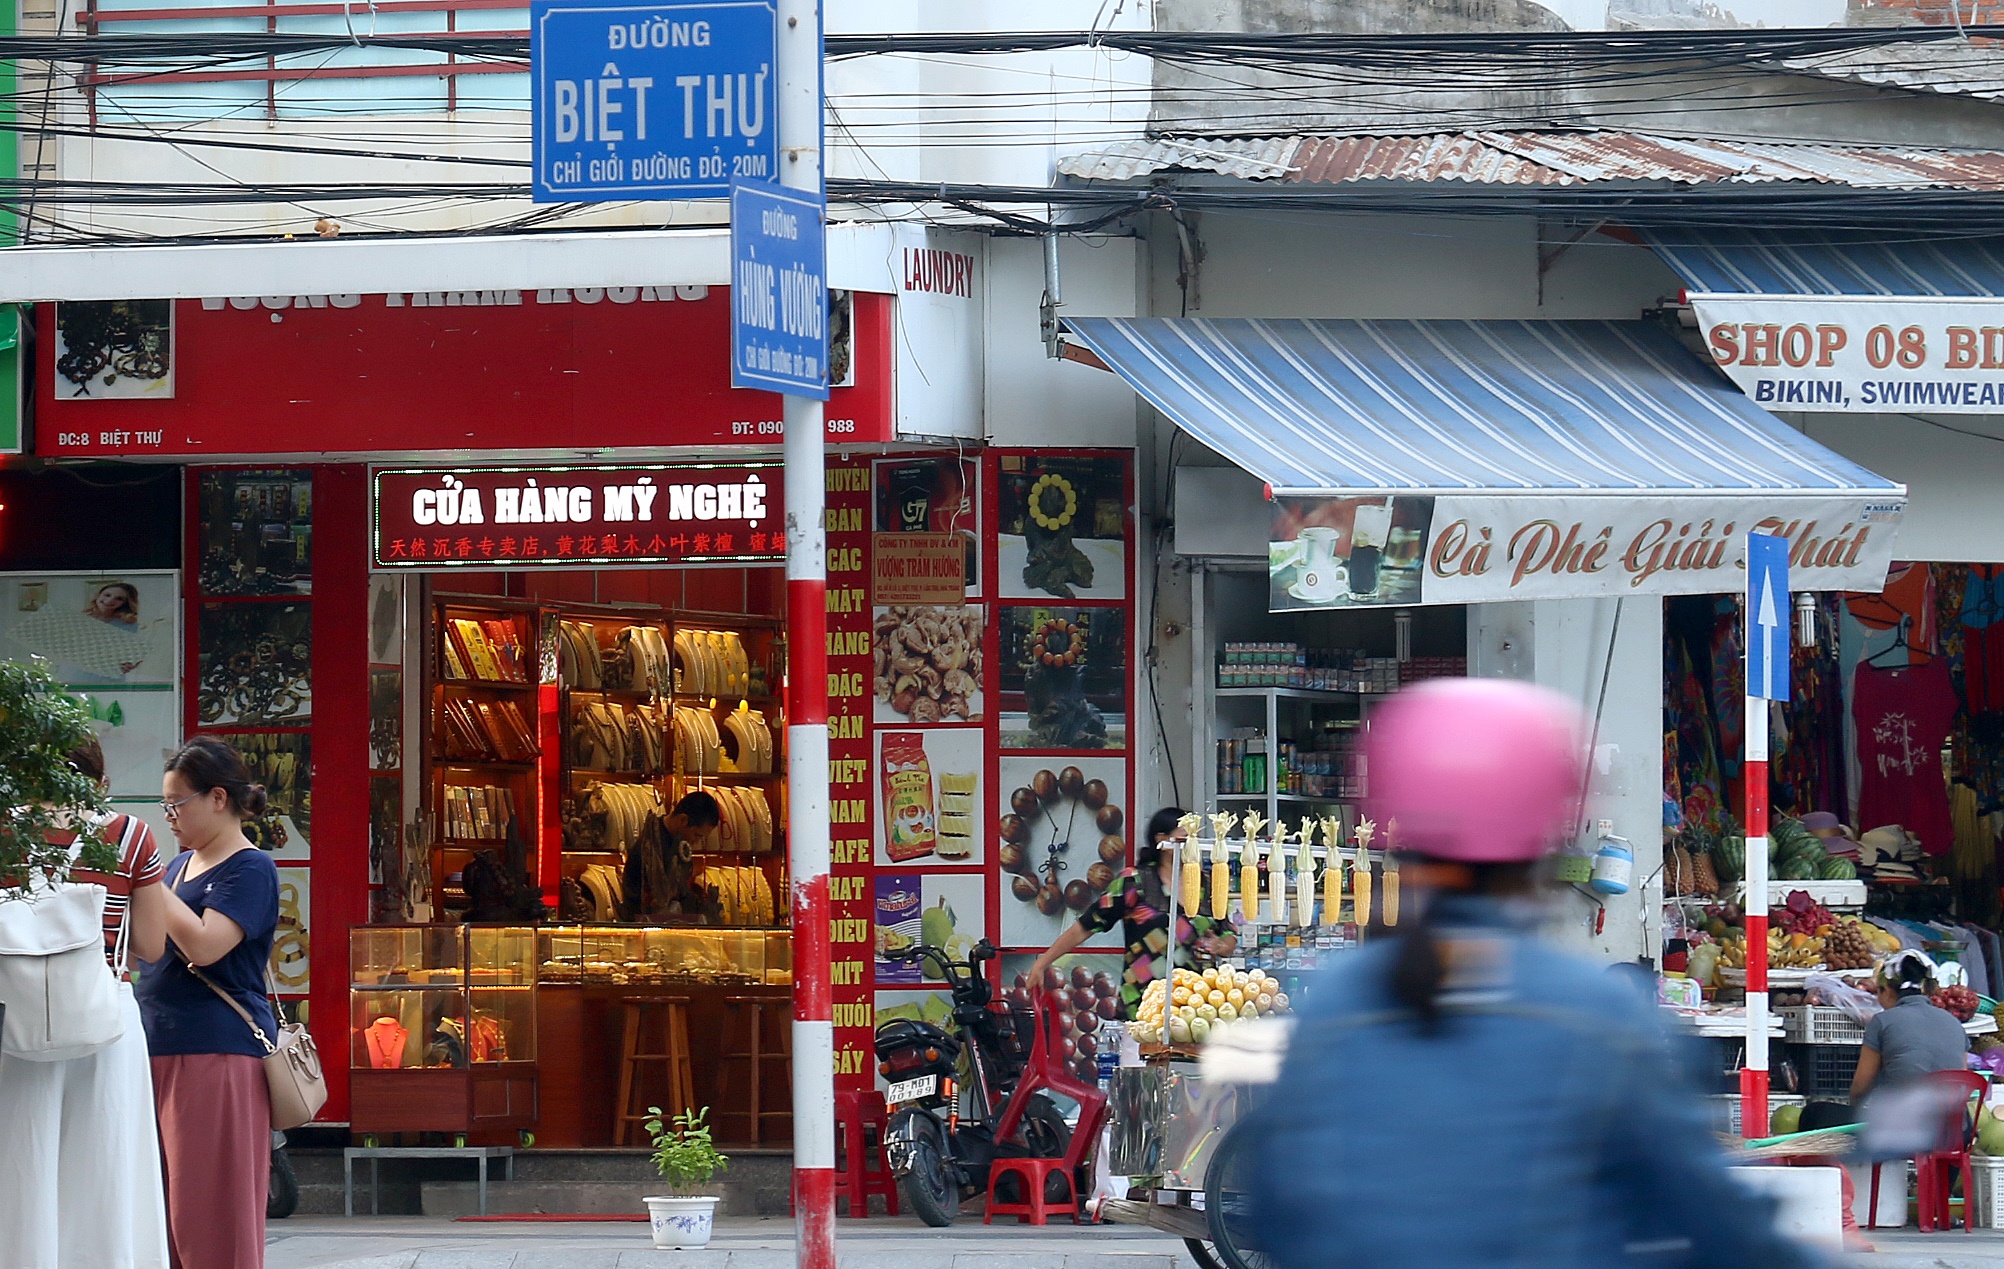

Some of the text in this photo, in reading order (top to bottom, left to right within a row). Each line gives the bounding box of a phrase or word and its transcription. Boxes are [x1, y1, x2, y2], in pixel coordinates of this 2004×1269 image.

[608, 15, 711, 50] ĐƯỜNG
[554, 62, 768, 150] BIỆT THỰ
[553, 146, 767, 183] CHỈ GIỚI ĐƯỜNG ĐỎ: 20M
[762, 205, 797, 240] ĐƯỜNG
[904, 247, 974, 298] LAUNDRY
[740, 245, 821, 340] HÙNG VƯƠNG
[1709, 322, 2004, 369] SHOP 08 BI
[1755, 380, 1850, 408] BIKINI,
[58, 428, 163, 447] ĐC:8 BIỆT THỰ
[732, 421, 754, 435] ĐT:
[826, 462, 870, 491] HUYÊN
[413, 473, 767, 528] CỬA HÀNG MỸ NGHỆ
[826, 502, 862, 531] BÁN
[902, 499, 928, 523] G7
[827, 542, 862, 571] CÁC
[1430, 518, 1493, 578] Cà
[1507, 518, 1613, 588] Phê
[1618, 517, 1728, 588] Giải
[825, 583, 864, 618] MẶT
[827, 667, 863, 703] ĐẶC
[827, 706, 863, 739] SẢN
[829, 799, 865, 823] NAM
[829, 877, 865, 906] HẠT
[830, 956, 863, 984] MÍT
[832, 995, 871, 1027] HUỐI
[832, 1041, 864, 1074] SẤY
